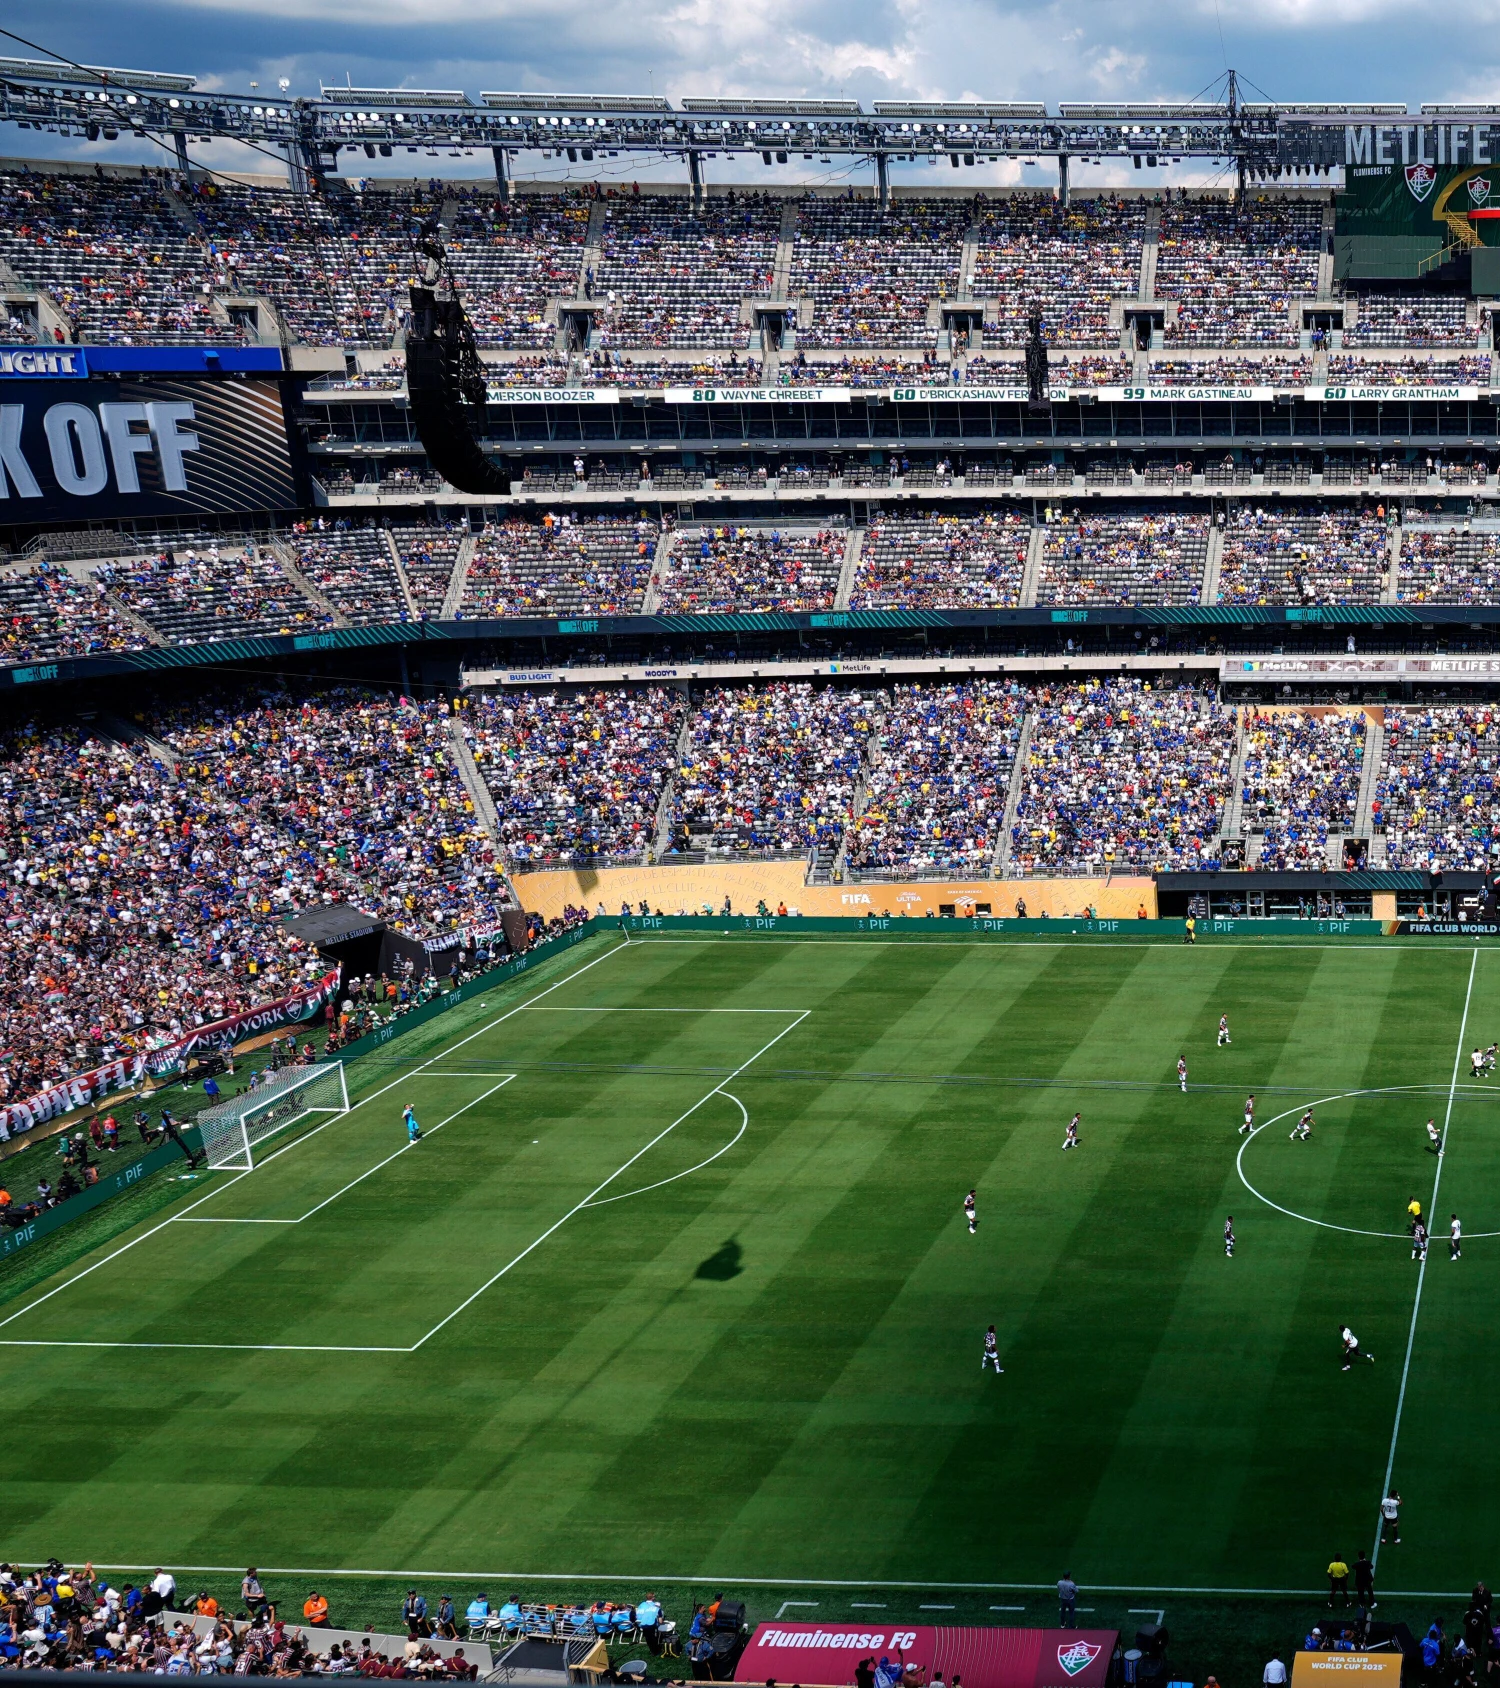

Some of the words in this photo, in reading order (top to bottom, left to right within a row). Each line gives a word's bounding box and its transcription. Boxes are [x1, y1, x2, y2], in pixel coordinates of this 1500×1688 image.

[1345, 124, 1491, 164] METLIFE
[486, 391, 544, 402] MERSON
[544, 391, 595, 401] BOOZER
[692, 390, 716, 402] 80
[721, 390, 767, 401] WAYNE
[769, 390, 823, 401] CHREBET
[893, 389, 916, 401] 60
[919, 389, 1006, 401] D'BRICKASHAW
[1007, 389, 1066, 401] FERON
[1123, 388, 1145, 400] 99
[1150, 388, 1186, 400] MARK
[1188, 388, 1253, 400] GASTINEAU
[1324, 388, 1347, 400] 60
[1351, 388, 1390, 399] LARRY
[1391, 388, 1459, 399] GRANTHAM
[44, 401, 200, 496] OFF
[833, 615, 849, 626] OFF
[1073, 611, 1088, 622] OFF
[1307, 609, 1322, 620] OFF
[582, 621, 599, 632] OFF
[319, 634, 335, 647] OFF
[1262, 662, 1309, 670] MetLife
[1430, 660, 1488, 671] METLIFE
[40, 665, 59, 679] OFF
[841, 894, 871, 905] FIFA
[642, 917, 663, 929] PIF
[756, 918, 776, 929] PIF
[870, 919, 890, 930] PIF
[983, 920, 1004, 931] PIF
[1099, 921, 1119, 932] PIF
[1214, 922, 1235, 932] PIF
[1329, 922, 1350, 933] PIF
[1409, 924, 1432, 932] FIFA
[1433, 924, 1459, 932] CLUB
[1460, 924, 1498, 933] WORLD
[325, 932, 349, 945] METLIFE
[349, 926, 374, 940] STADIUM
[573, 929, 584, 941] PIF
[516, 958, 527, 971] PIF
[450, 990, 462, 1004] PIF
[198, 1023, 240, 1049] NEW
[239, 1008, 284, 1032] YORK
[380, 1026, 394, 1041] PIF
[125, 1163, 143, 1181] PIF
[15, 1224, 36, 1246] PIF
[757, 1629, 885, 1649] Fluminense
[888, 1631, 916, 1650] FC
